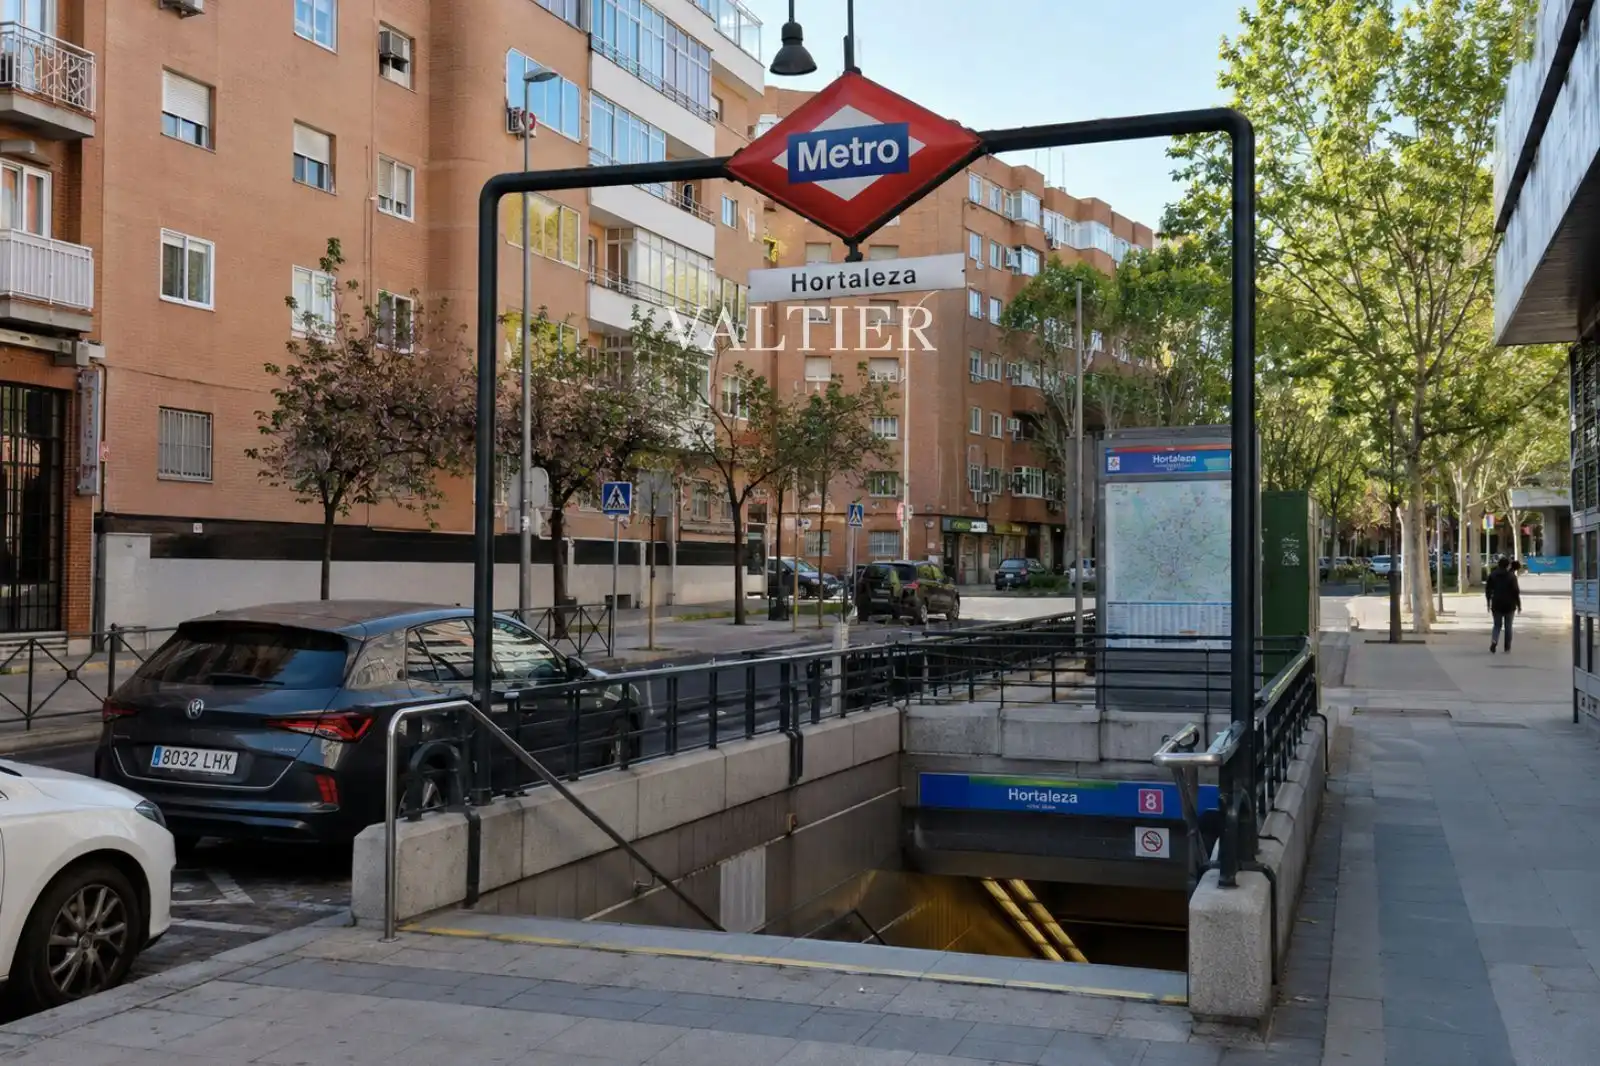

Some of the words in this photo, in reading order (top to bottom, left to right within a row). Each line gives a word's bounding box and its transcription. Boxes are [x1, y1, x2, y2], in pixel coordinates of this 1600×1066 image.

[798, 137, 900, 172] Metro
[791, 267, 917, 292] Hortaleza
[162, 749, 199, 767] 8032
[203, 752, 233, 771] LHX
[1008, 788, 1078, 804] Hortaleza
[1145, 792, 1157, 810] 8
